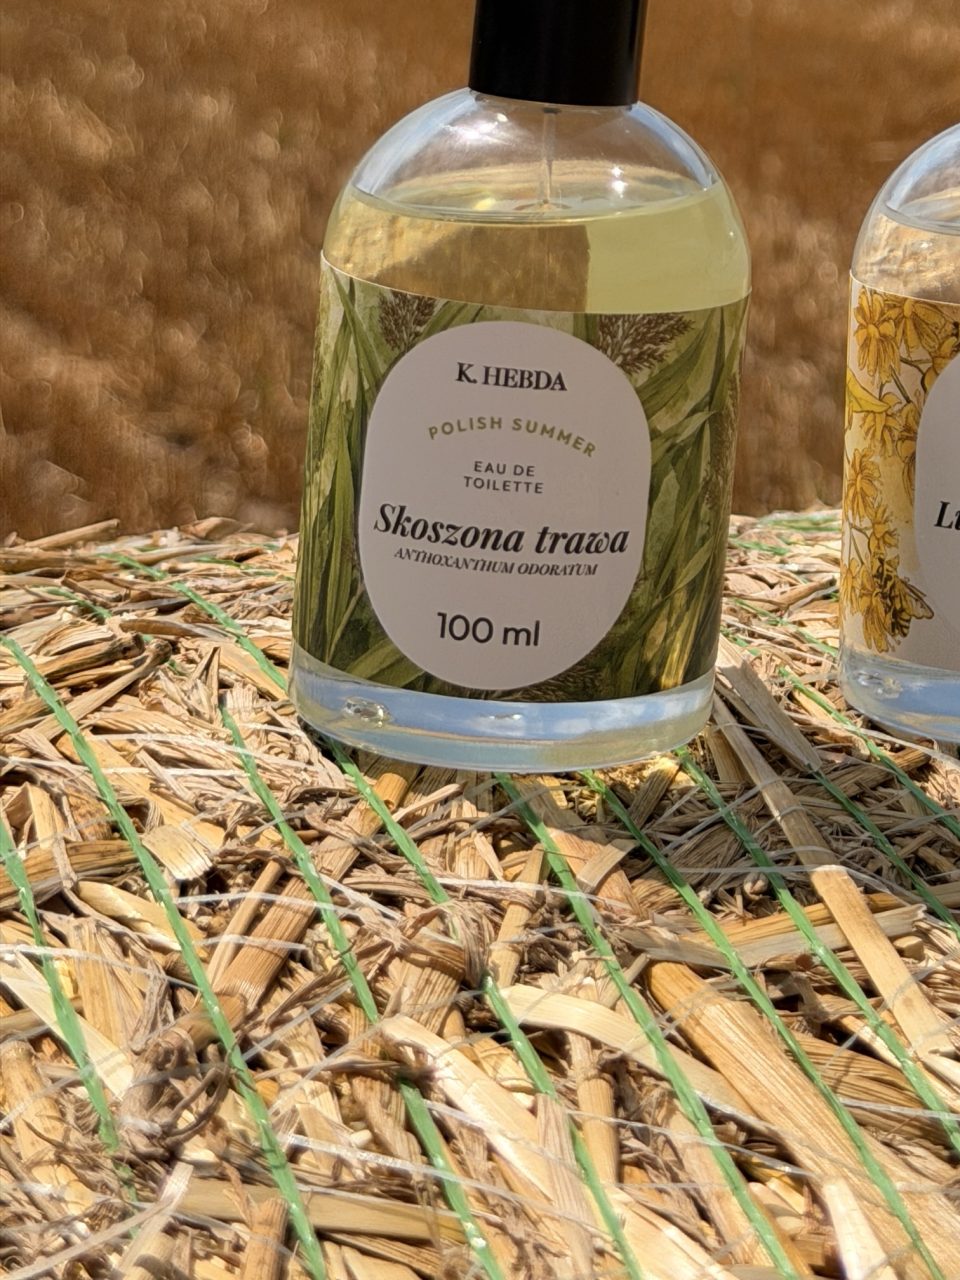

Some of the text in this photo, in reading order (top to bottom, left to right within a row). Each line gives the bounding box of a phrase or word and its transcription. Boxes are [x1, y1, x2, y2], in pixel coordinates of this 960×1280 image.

[455, 362, 567, 391] K. HEBDA
[428, 417, 596, 457] POLISH SUMMER
[473, 461, 535, 477] EAU DE
[463, 476, 544, 494] TOILETTE
[373, 503, 630, 554] Skoszona trawa
[394, 548, 597, 576] ANTHOXANTHUM ODORATUM
[437, 612, 540, 647] 100 ml
